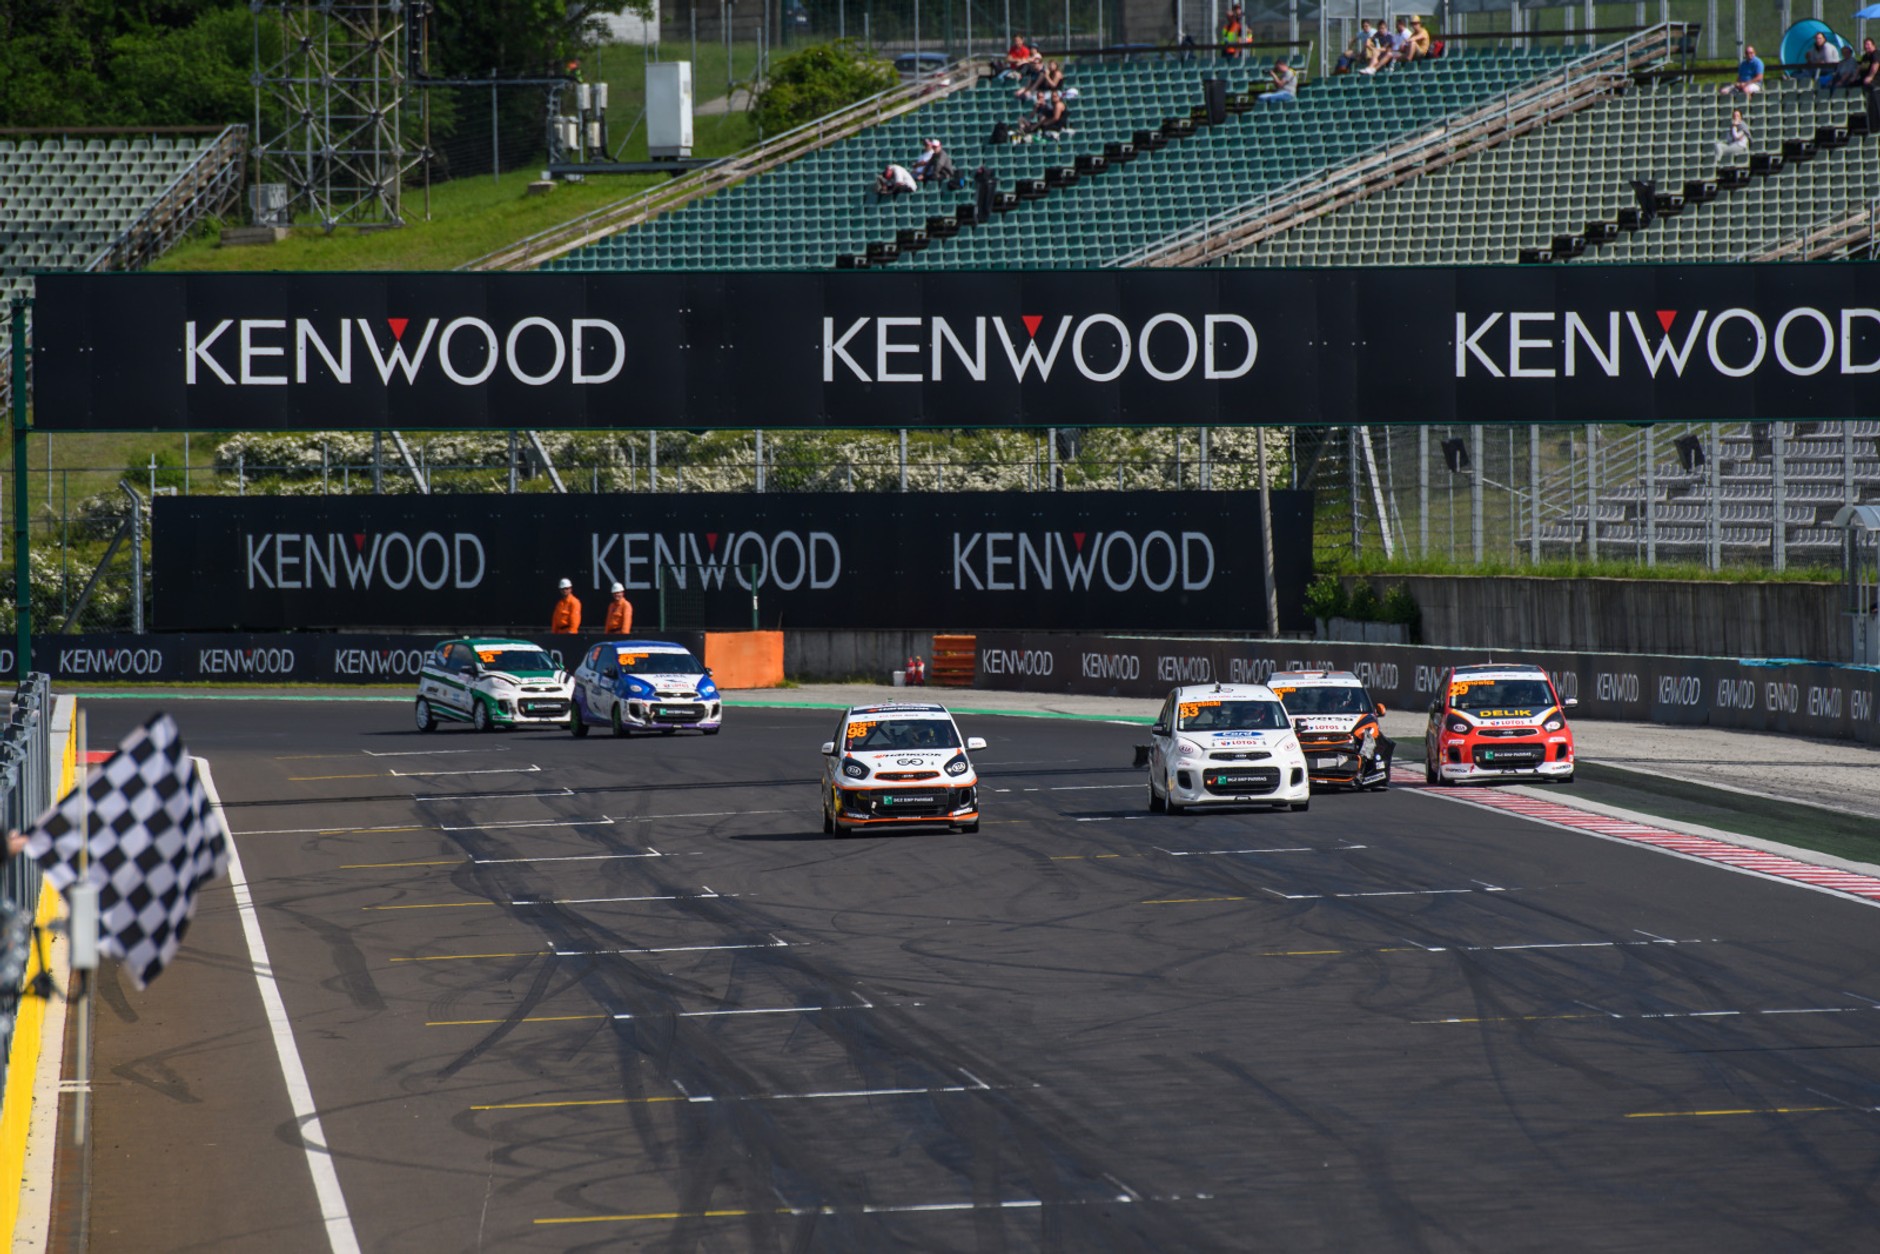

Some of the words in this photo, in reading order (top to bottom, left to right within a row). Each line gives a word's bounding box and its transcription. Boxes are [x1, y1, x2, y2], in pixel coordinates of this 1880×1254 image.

[186, 317, 626, 386] KENWOOD
[823, 313, 1258, 384] KENWOOD
[1455, 308, 1880, 379] KENWOOD
[247, 532, 485, 590] KENWOOD
[592, 531, 841, 591] KENWOOD
[954, 530, 1215, 592] KENWOOD
[59, 648, 163, 675] KENWOOD
[199, 647, 295, 674] KENWOOD
[480, 653, 496, 663] 12
[618, 656, 635, 666] 66
[982, 649, 1054, 676] KENWOOD
[1082, 652, 1140, 681] KENWOOD
[1157, 655, 1211, 683] KENWOOD
[1449, 683, 1469, 697] 29
[1596, 672, 1640, 702] KENWOOD
[1479, 709, 1532, 717] DELIK
[847, 727, 867, 739] 98
